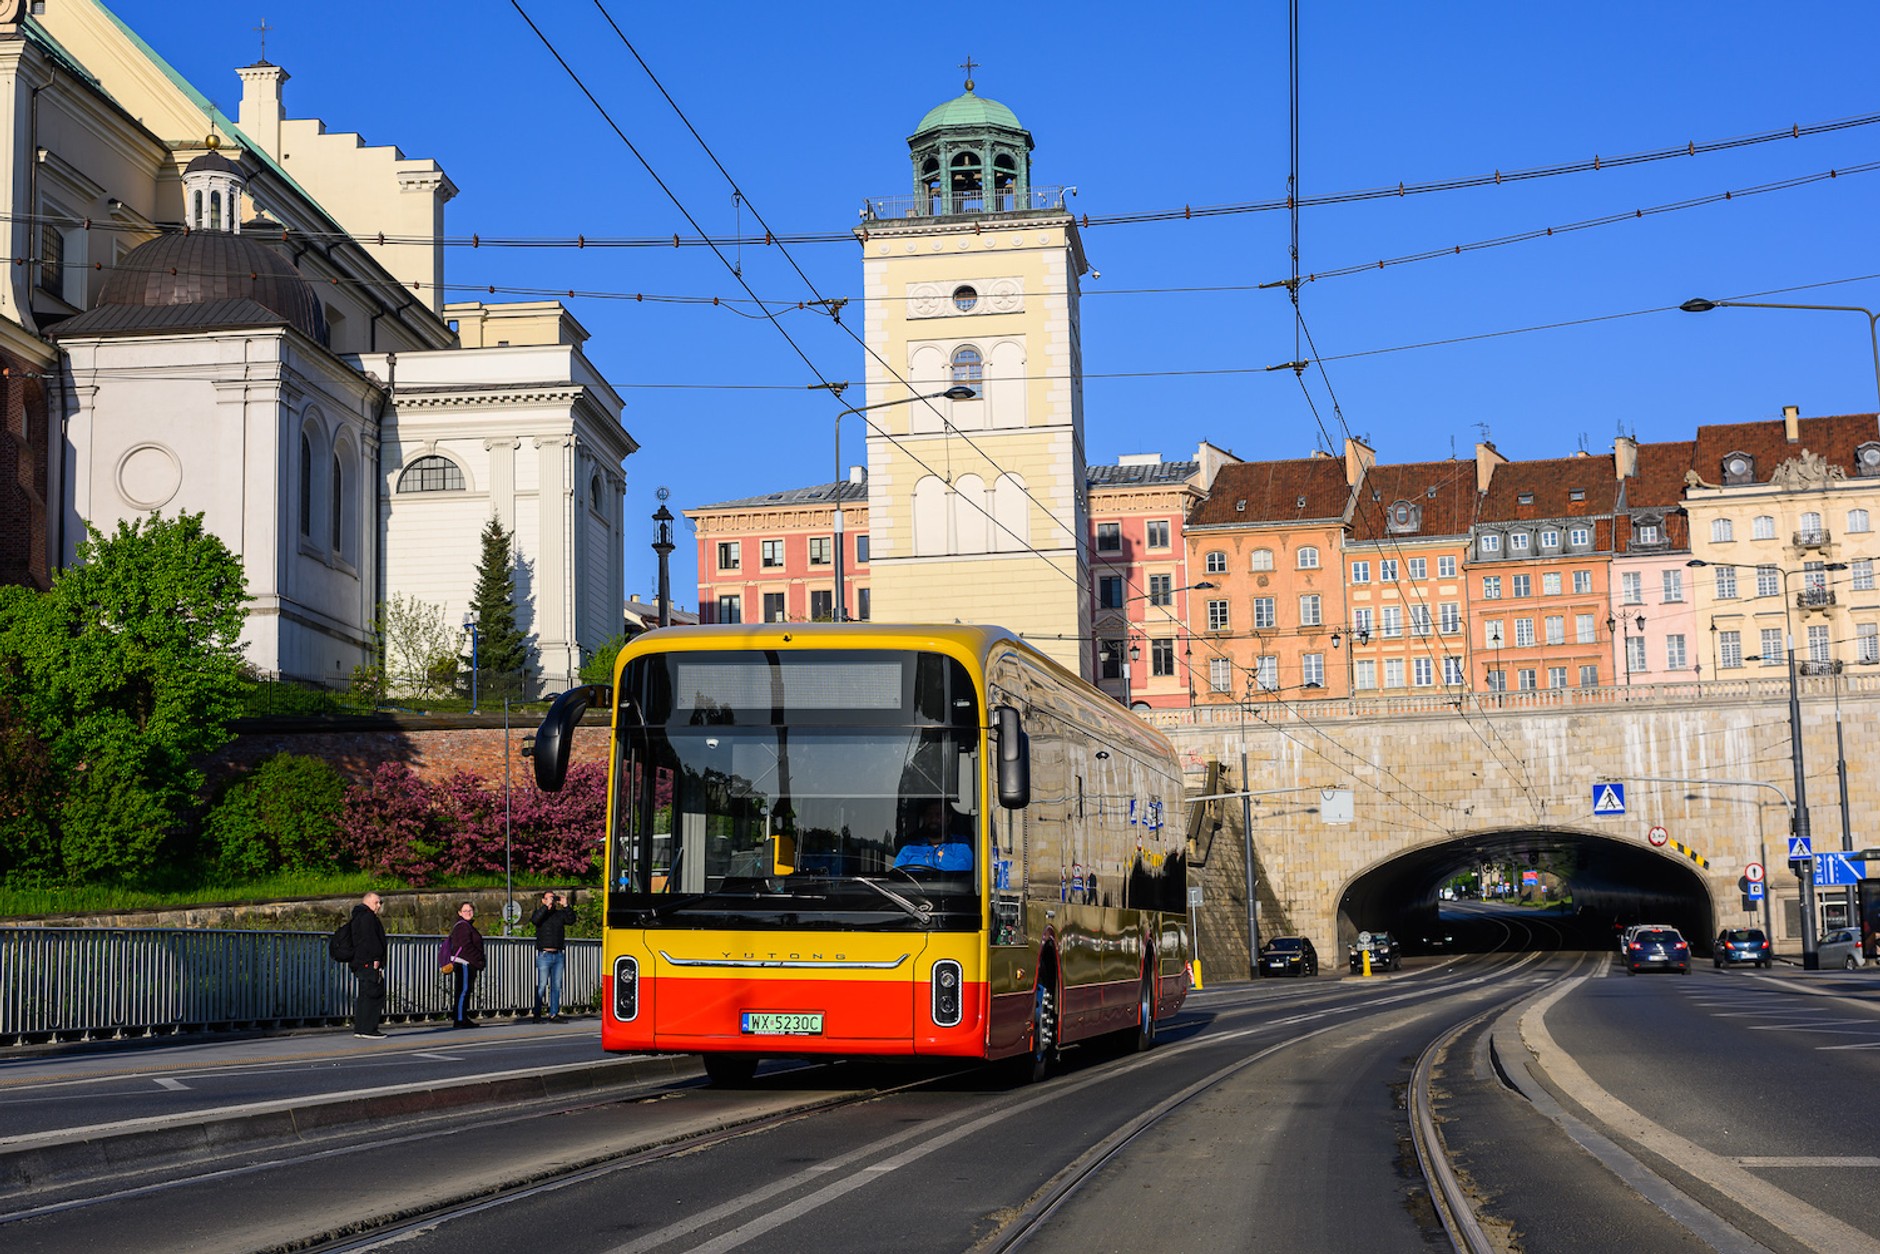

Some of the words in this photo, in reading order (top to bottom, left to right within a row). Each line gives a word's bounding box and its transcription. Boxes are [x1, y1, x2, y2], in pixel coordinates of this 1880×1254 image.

[722, 952, 846, 960] YUTONG
[751, 1015, 770, 1030] WX
[775, 1015, 819, 1031] 5230C
